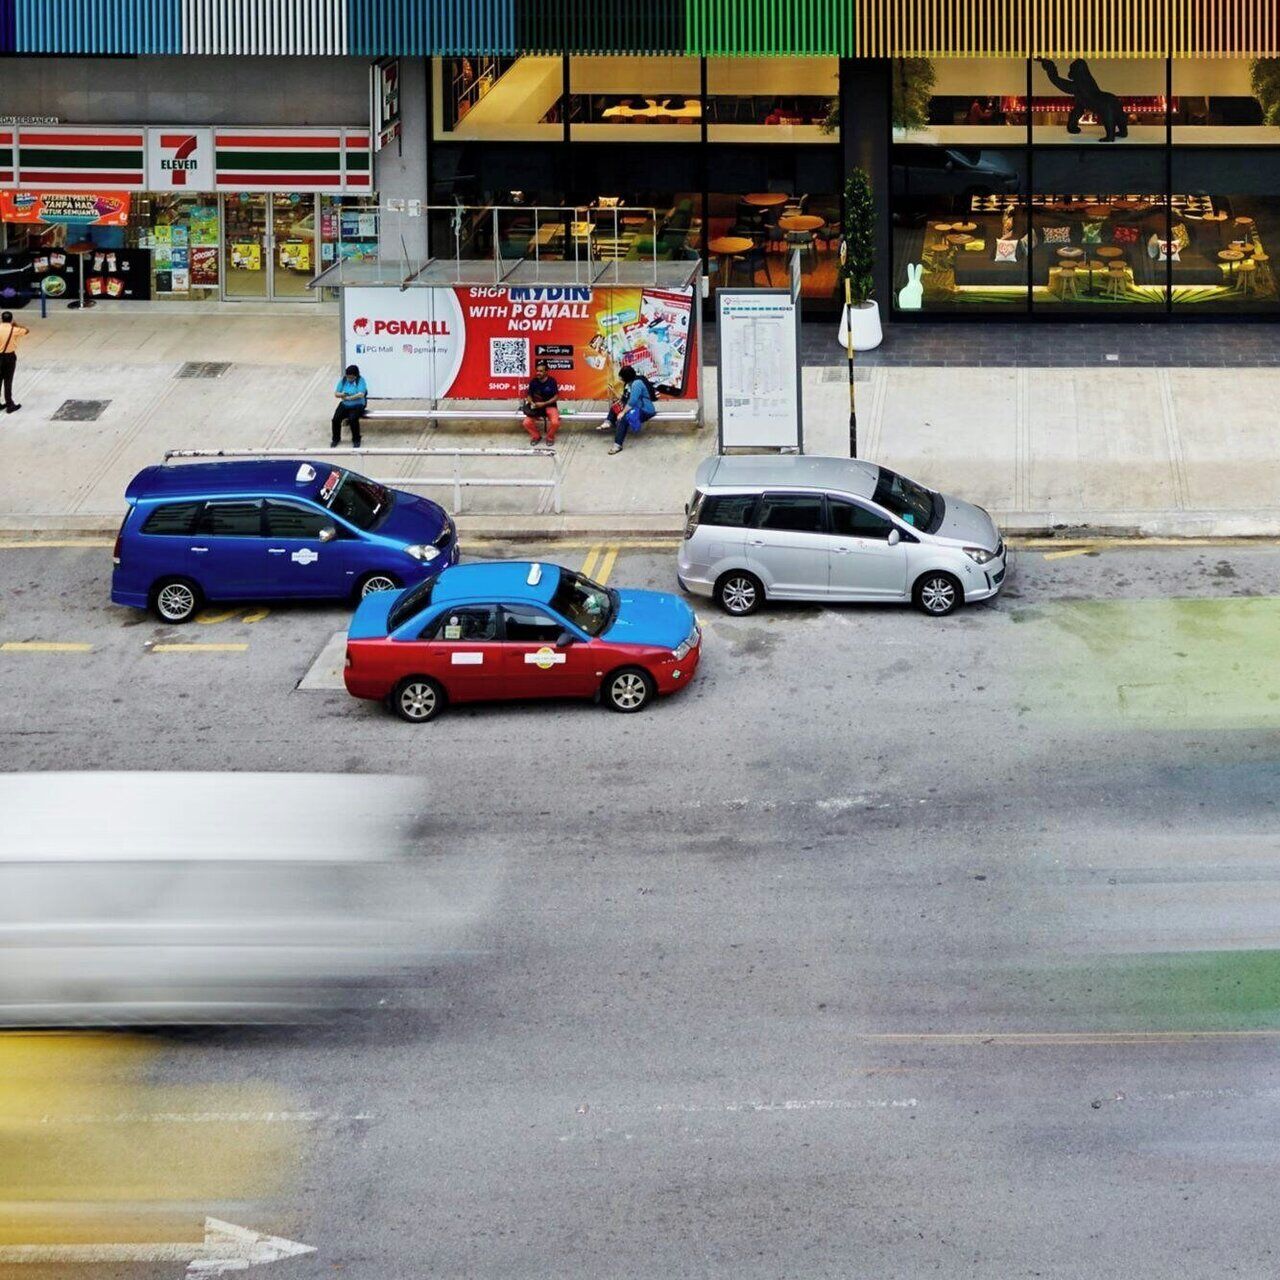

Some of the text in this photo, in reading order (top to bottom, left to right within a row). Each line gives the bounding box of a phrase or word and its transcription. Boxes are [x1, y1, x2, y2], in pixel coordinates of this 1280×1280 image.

[161, 135, 197, 184] 7
[469, 287, 591, 301] SHOP MYDIN
[469, 304, 590, 318] WITH PG MALL
[374, 320, 451, 335] PGMALL
[508, 319, 553, 331] NOW!
[366, 344, 377, 352] PG
